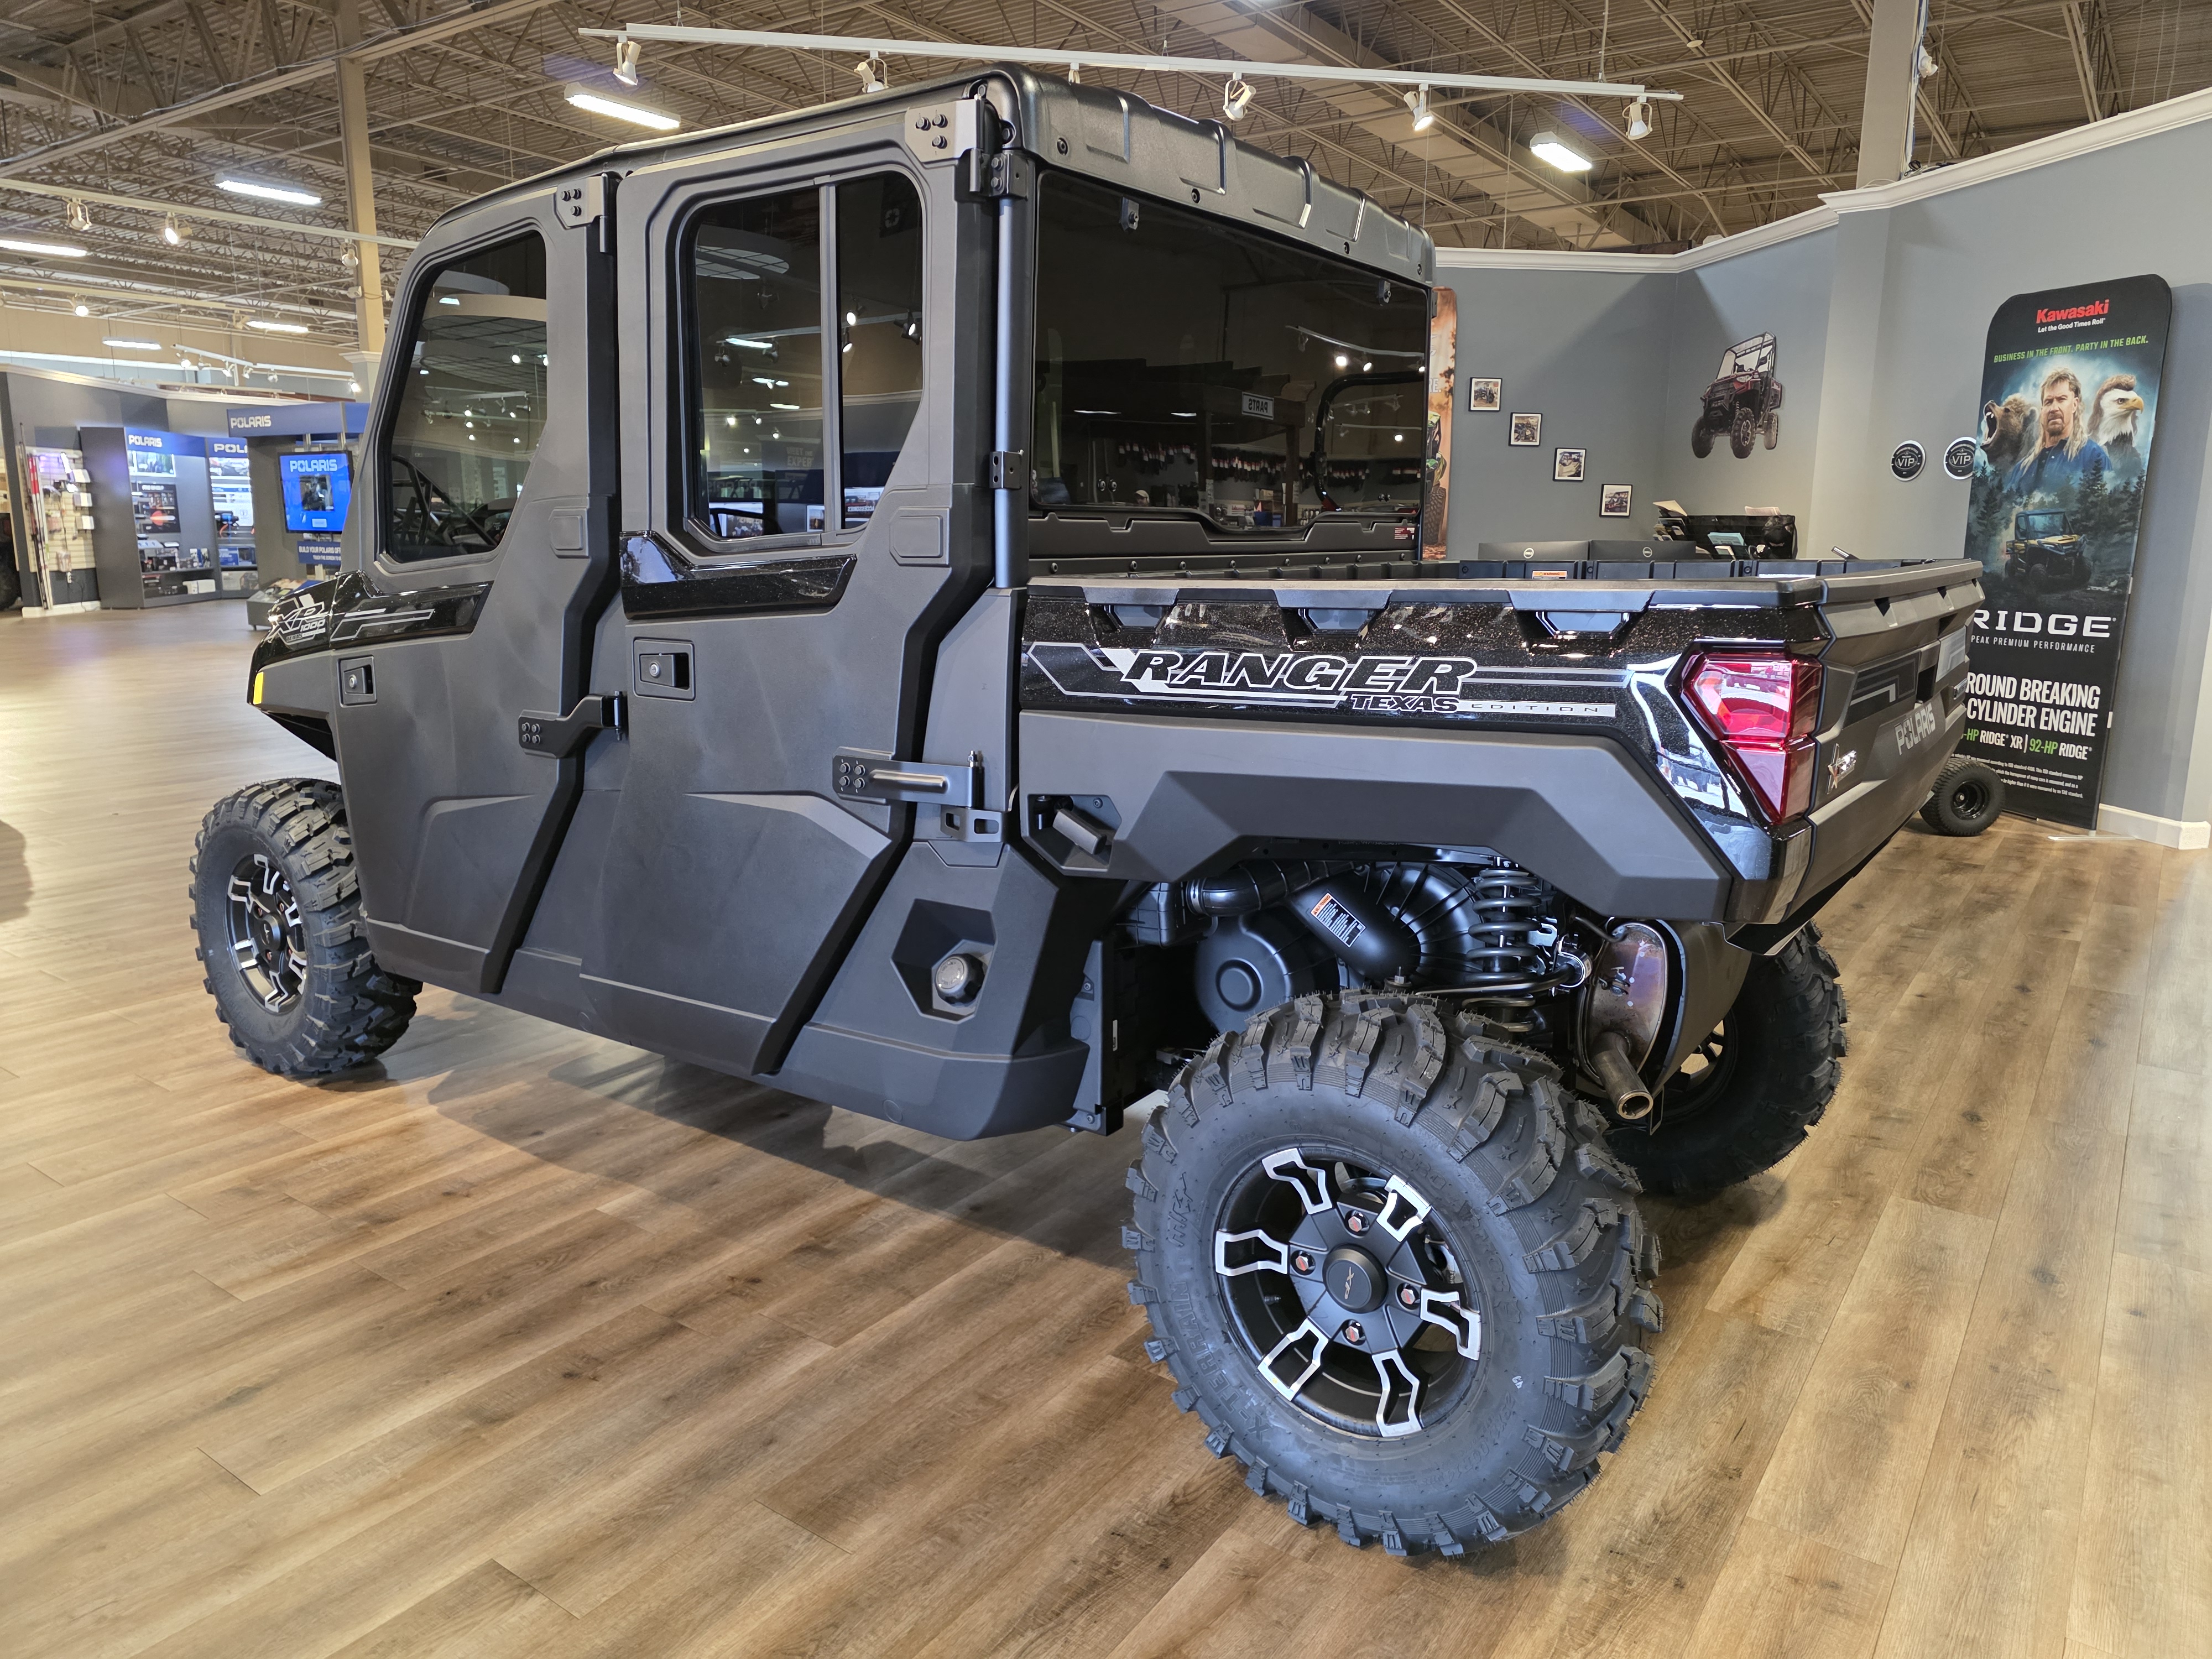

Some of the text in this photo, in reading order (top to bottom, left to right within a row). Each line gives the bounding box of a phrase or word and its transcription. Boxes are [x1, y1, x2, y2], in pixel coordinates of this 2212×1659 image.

[2036, 299, 2110, 324] Kawasaki
[2058, 322, 2073, 330] Good
[1994, 335, 2148, 363] BUSINESS IN THE FRONT. PARTY IN THE BACK.
[231, 415, 272, 429] POLARIS
[128, 435, 162, 447] POLARIS
[290, 459, 338, 472] POLARIS
[1898, 458, 1915, 467] VIP
[1952, 455, 1971, 465] VIP
[300, 619, 325, 632] 1000
[1971, 635, 2095, 653] PEAK PREMIUM PERFORMANCE
[1120, 649, 1478, 695] RANGER
[2020, 678, 2101, 709] BREAKING
[1350, 694, 1599, 713] TEXAS EDITION
[1966, 697, 2098, 737] CYLINDER ENGINE
[1894, 702, 1936, 755] POLARIS
[2010, 734, 2022, 749] XR
[2030, 738, 2058, 754] 92-HP
[1169, 1281, 1273, 1444] X-TERRAIN
